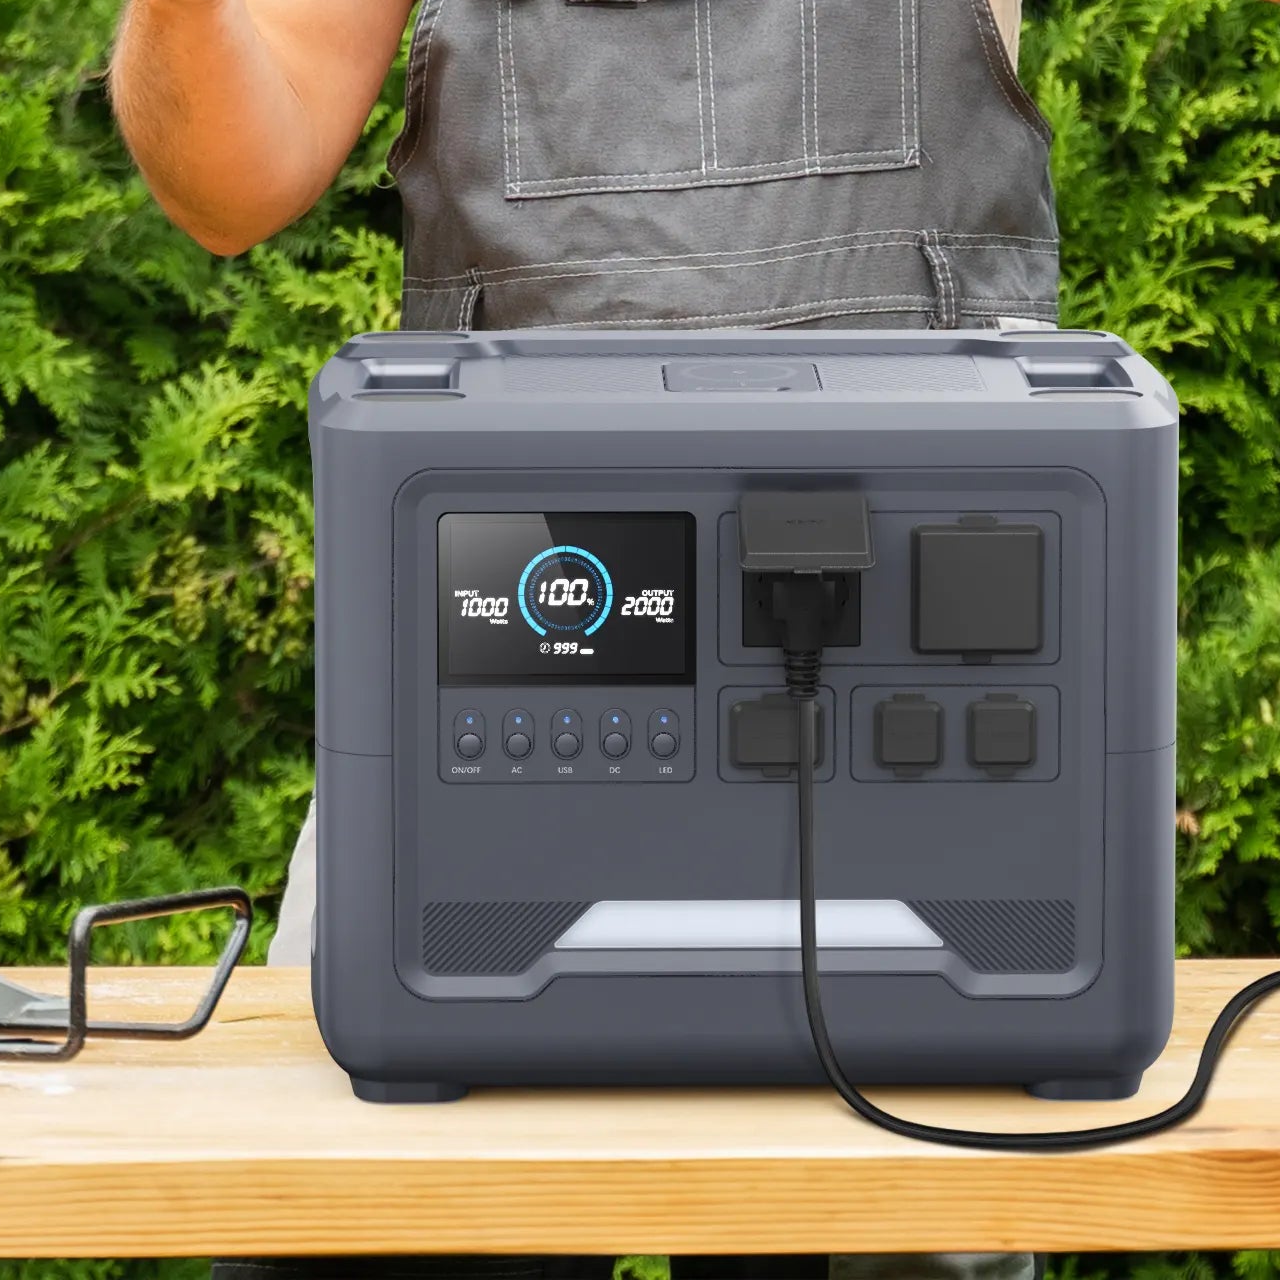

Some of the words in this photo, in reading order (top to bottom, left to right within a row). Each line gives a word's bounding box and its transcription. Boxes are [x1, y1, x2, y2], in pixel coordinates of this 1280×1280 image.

[454, 589, 480, 598] INPUT
[641, 589, 675, 597] OUTPUT
[461, 597, 509, 617] 1000
[621, 596, 675, 616] 2000
[553, 642, 578, 655] 999
[451, 766, 481, 774] ON/OFF
[511, 766, 523, 774] AC
[557, 766, 573, 774] USB
[609, 766, 621, 774] DC
[658, 766, 673, 774] LED
